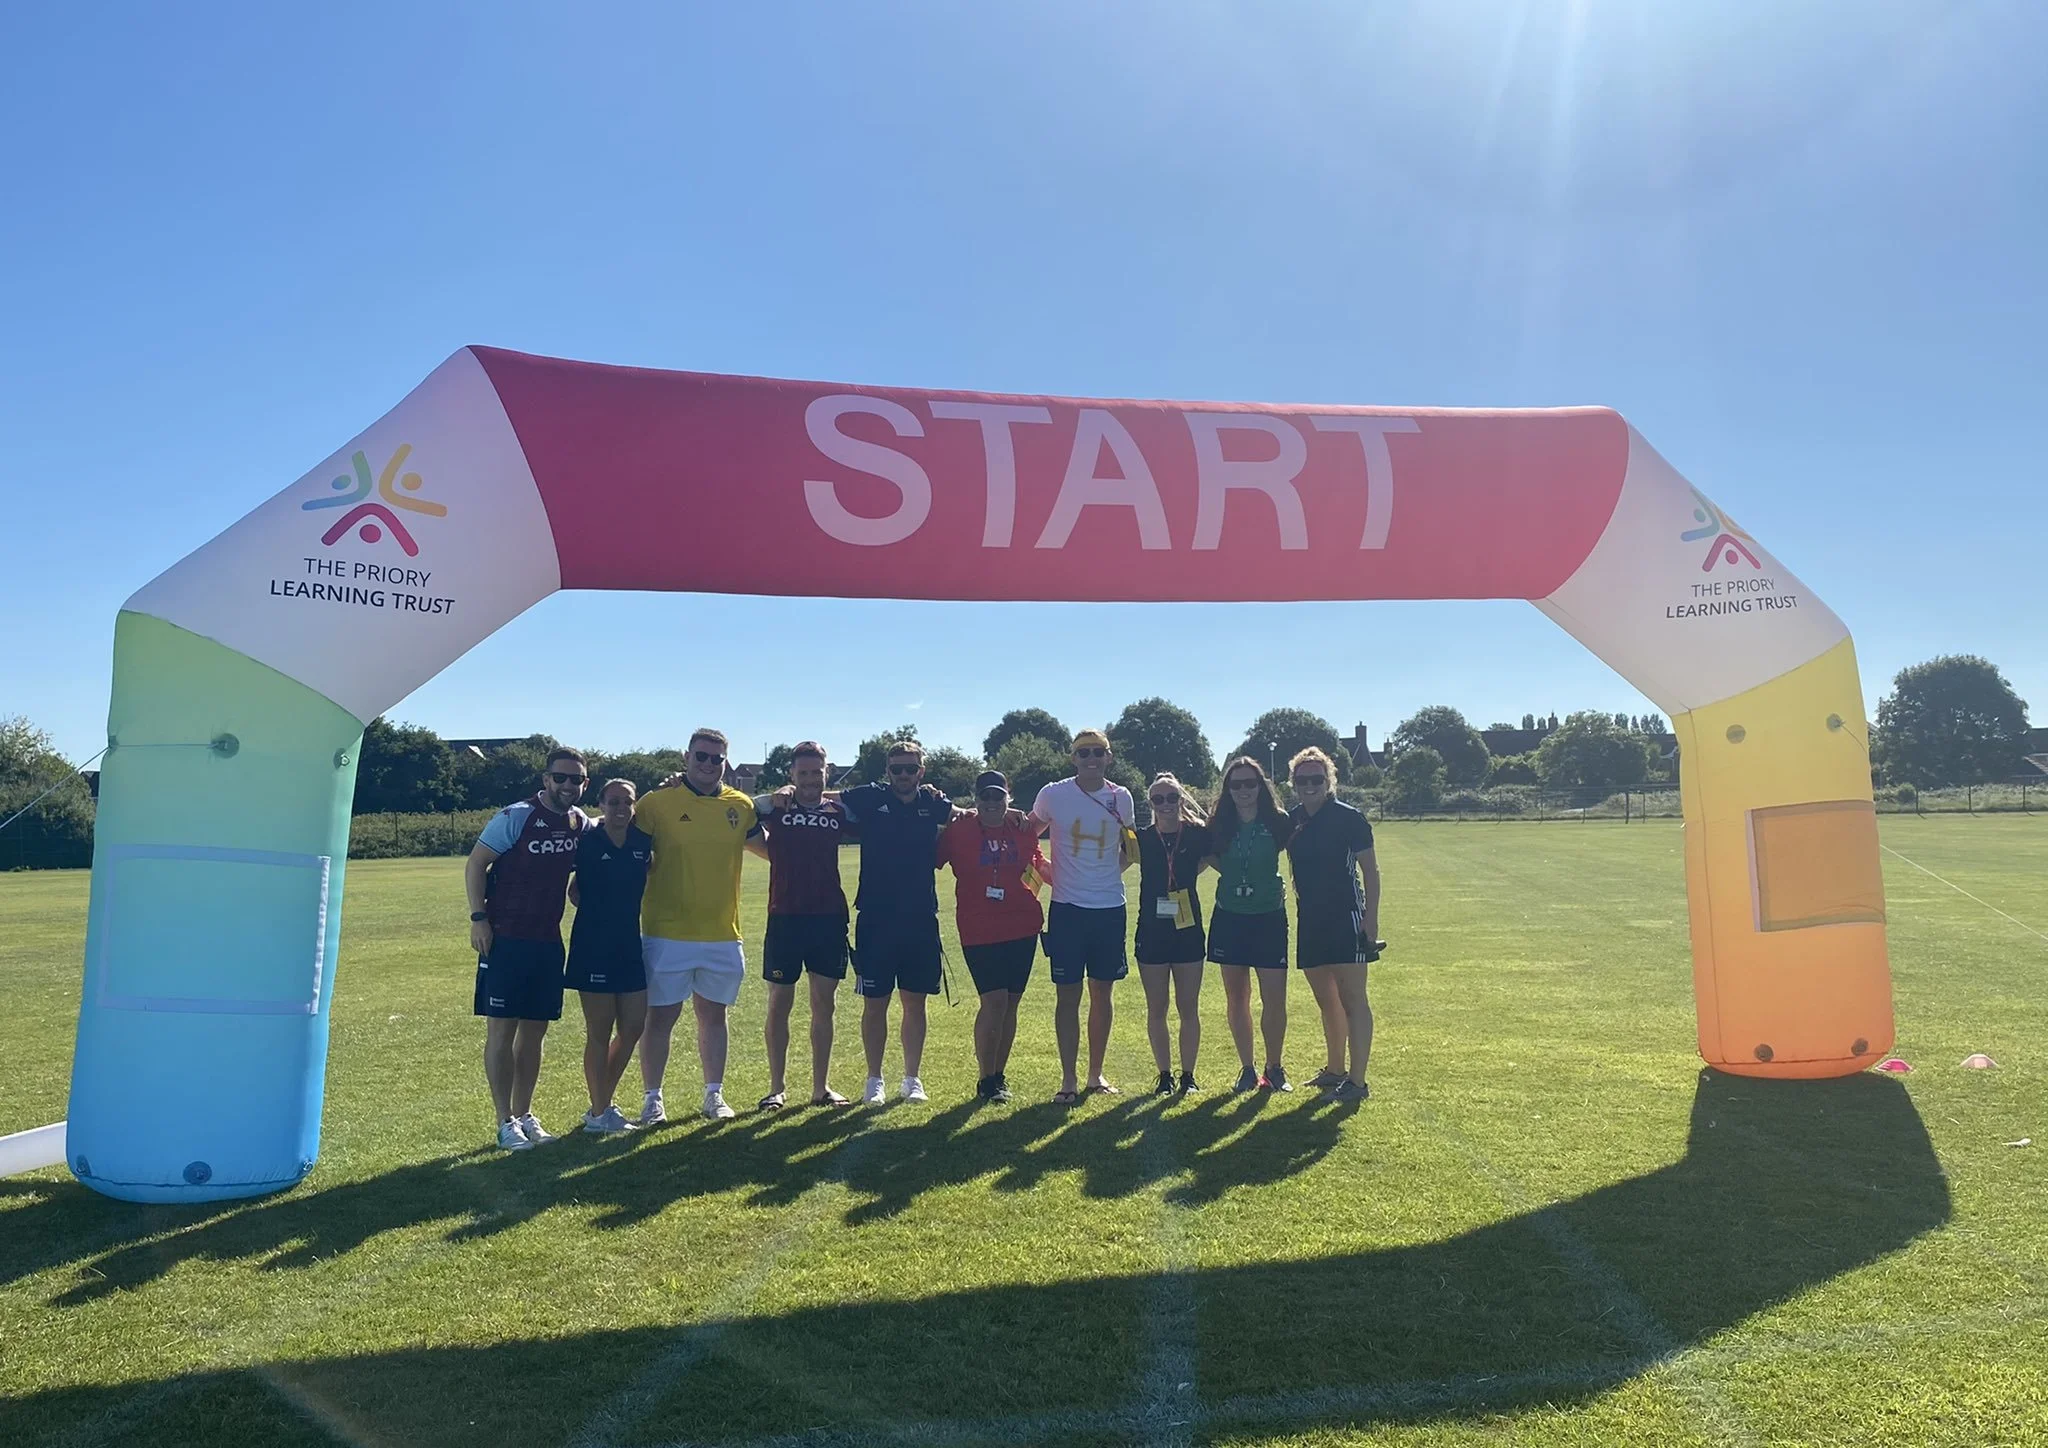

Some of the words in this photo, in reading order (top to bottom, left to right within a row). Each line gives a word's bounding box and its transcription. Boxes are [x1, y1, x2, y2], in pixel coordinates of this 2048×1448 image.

[803, 394, 1422, 550] START
[304, 557, 346, 577] THE
[354, 562, 431, 587] PRIORY
[270, 579, 385, 607] LEARNING
[392, 592, 455, 614] TRUST
[1691, 582, 1722, 597] THE
[1727, 578, 1775, 594] PRIORY
[1666, 599, 1752, 618] LEARNING
[1756, 596, 1798, 611] TRUST
[781, 813, 839, 830] CAZOO
